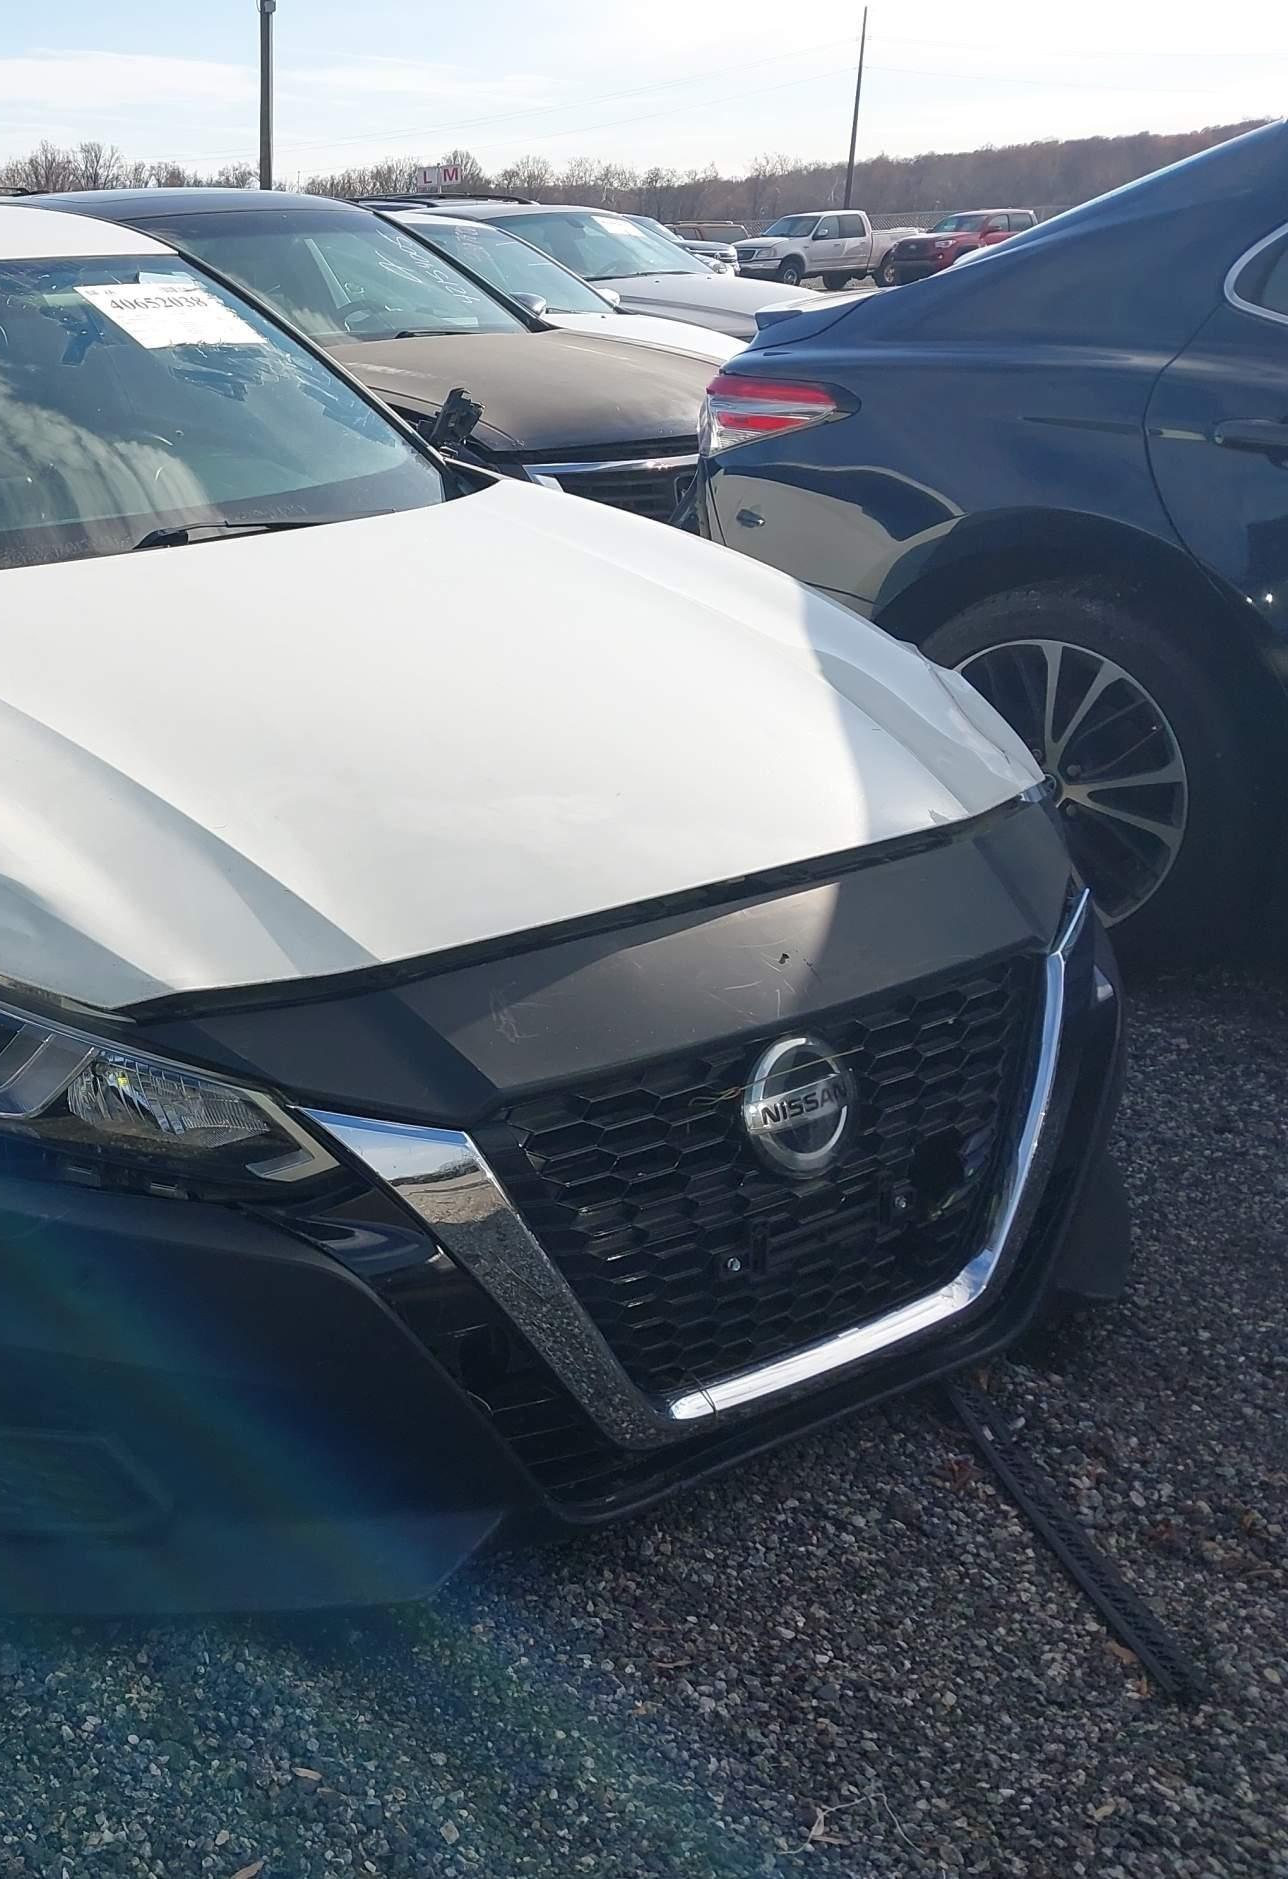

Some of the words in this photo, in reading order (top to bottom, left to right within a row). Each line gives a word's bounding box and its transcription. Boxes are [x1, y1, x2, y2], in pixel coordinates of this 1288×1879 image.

[423, 170, 433, 184] L
[443, 167, 459, 183] M
[109, 295, 208, 312] 40652038
[761, 1082, 848, 1126] NISSAN
